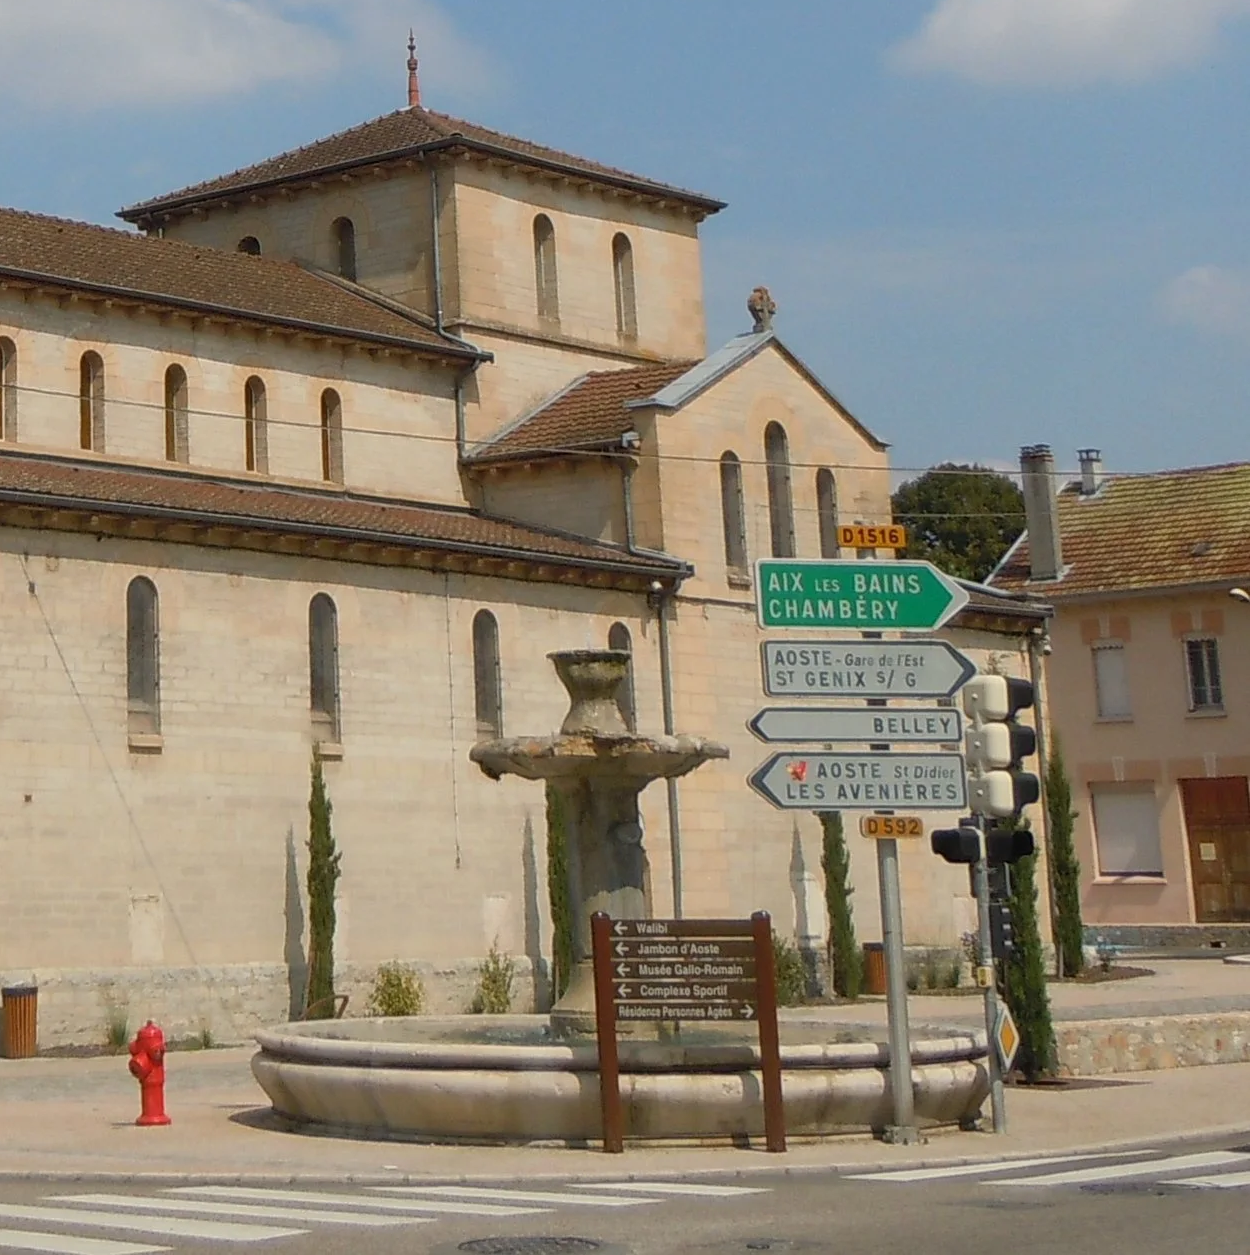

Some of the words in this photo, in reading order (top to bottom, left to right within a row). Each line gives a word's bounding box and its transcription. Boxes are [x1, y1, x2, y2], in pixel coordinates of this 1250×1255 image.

[768, 572, 803, 592] AIX
[814, 579, 840, 592] LES
[854, 574, 921, 594] BAINS
[769, 595, 899, 620] CHAMBÉRY
[774, 650, 832, 666] AOSTE
[844, 653, 874, 666] Gare
[878, 654, 893, 666] de
[805, 671, 866, 687] GENIX
[905, 672, 916, 687] G
[873, 717, 950, 734] BELLEY
[817, 762, 881, 779] AOSTE
[894, 766, 908, 779] St
[914, 766, 955, 779] Didier
[786, 784, 825, 800] LES
[837, 780, 958, 800] AVENIÈRES
[884, 819, 920, 835] 592
[636, 922, 668, 934] Walibi
[638, 943, 678, 955] Jambon
[681, 943, 720, 955] d'Aoste
[639, 964, 671, 976] Musée
[674, 964, 743, 976] Gallo-Romain
[640, 985, 690, 998] Complexe
[693, 984, 728, 998] Sportif
[619, 1005, 660, 1017] Résidence
[662, 1006, 705, 1017] Personnes
